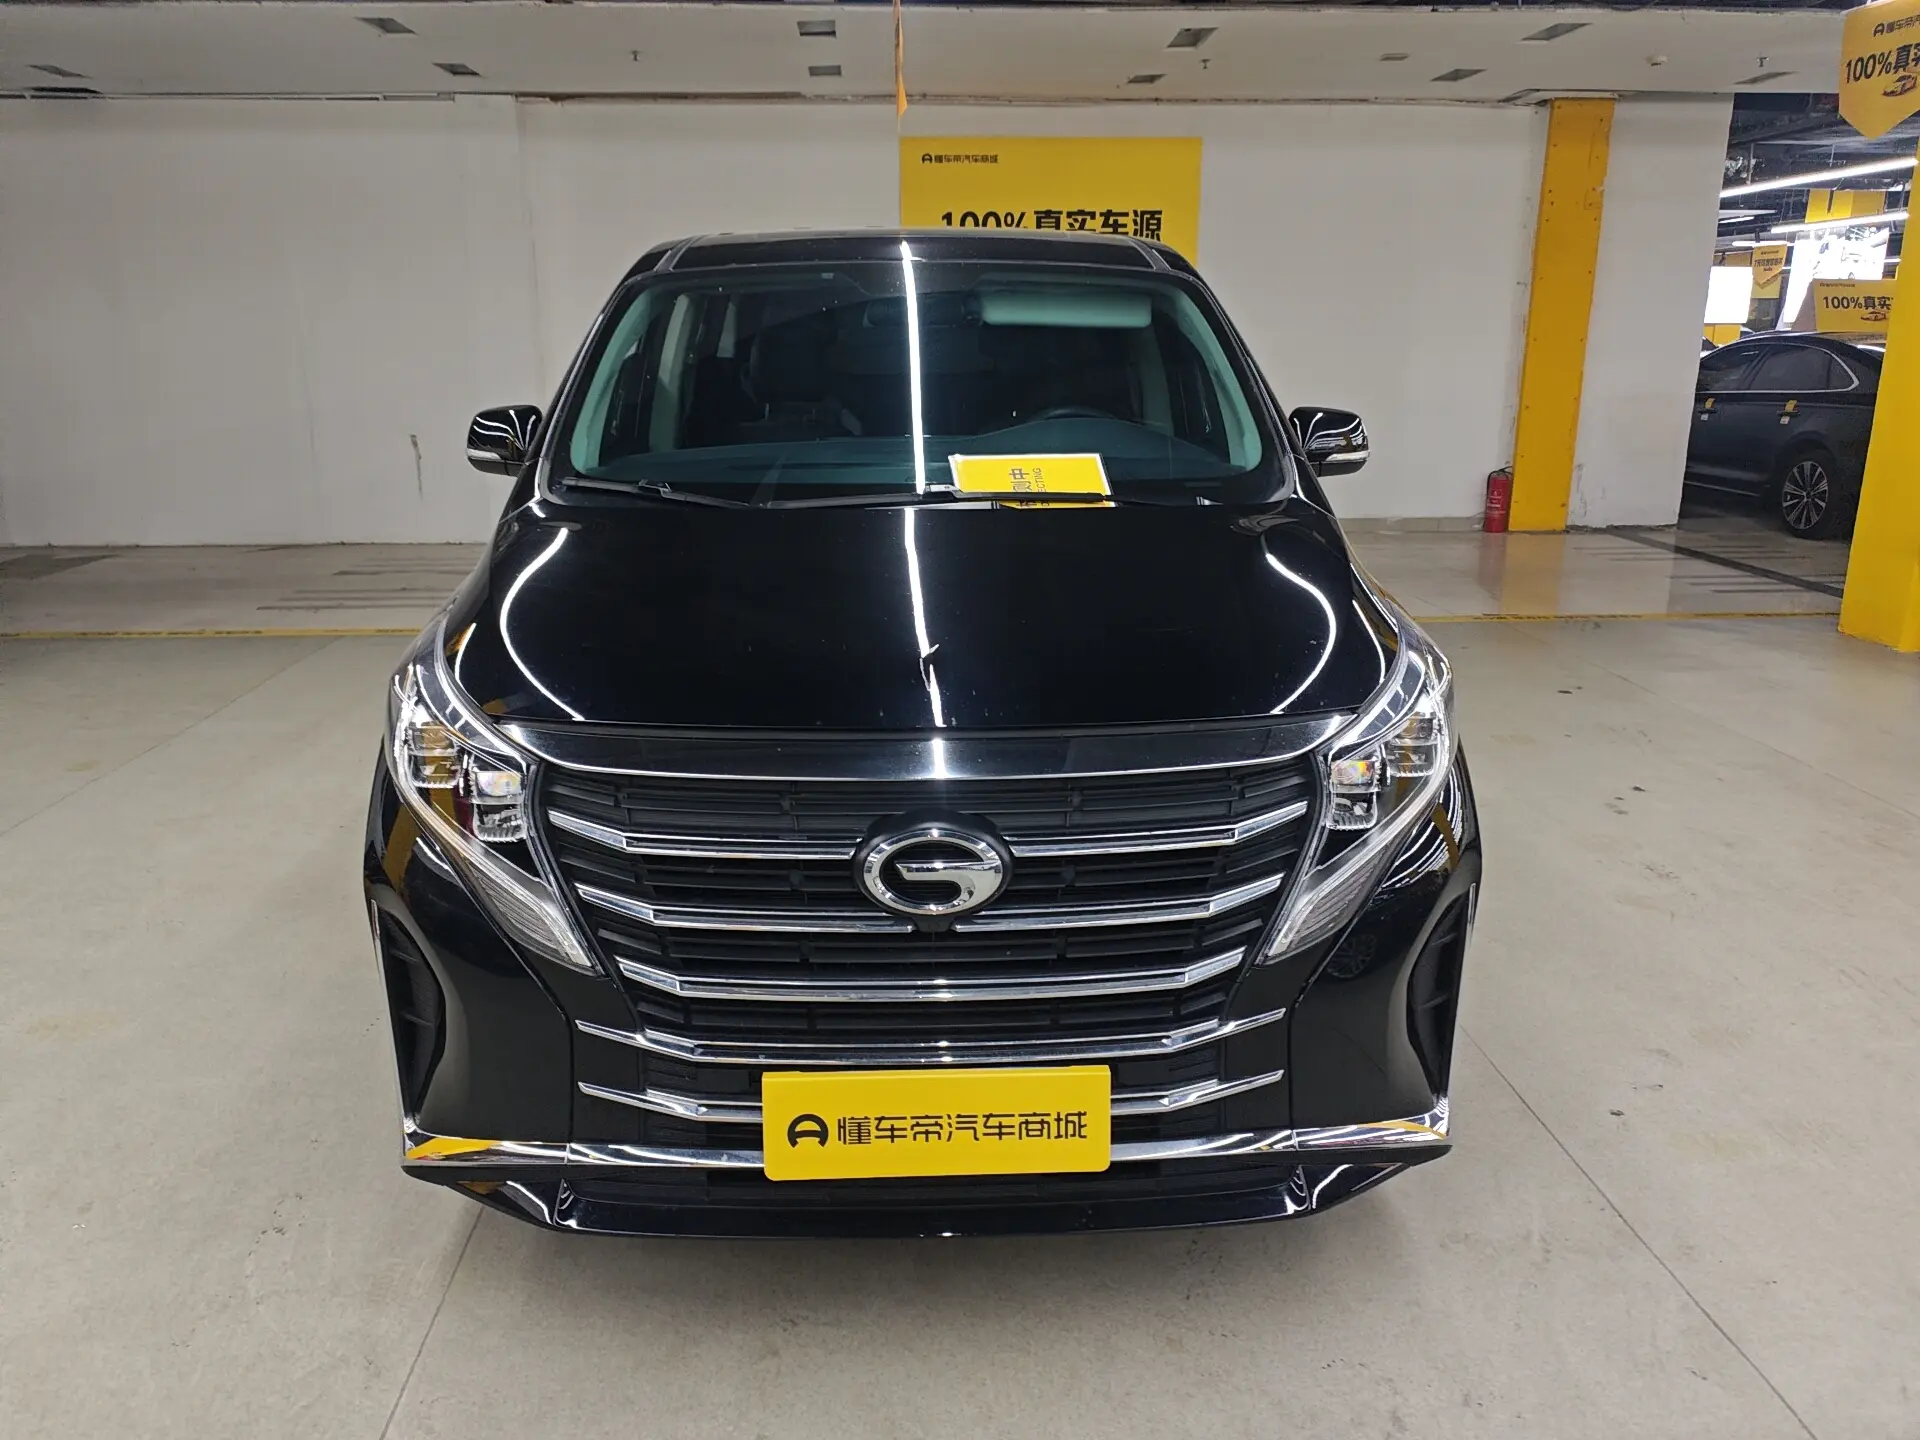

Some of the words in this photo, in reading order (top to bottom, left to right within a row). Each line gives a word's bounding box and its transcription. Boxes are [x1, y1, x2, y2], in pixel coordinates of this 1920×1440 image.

[941, 209, 1162, 241] 100%真实车源
[1823, 296, 1893, 310] 100%真实
[837, 1110, 1088, 1145] 懂车帝汽车商城
